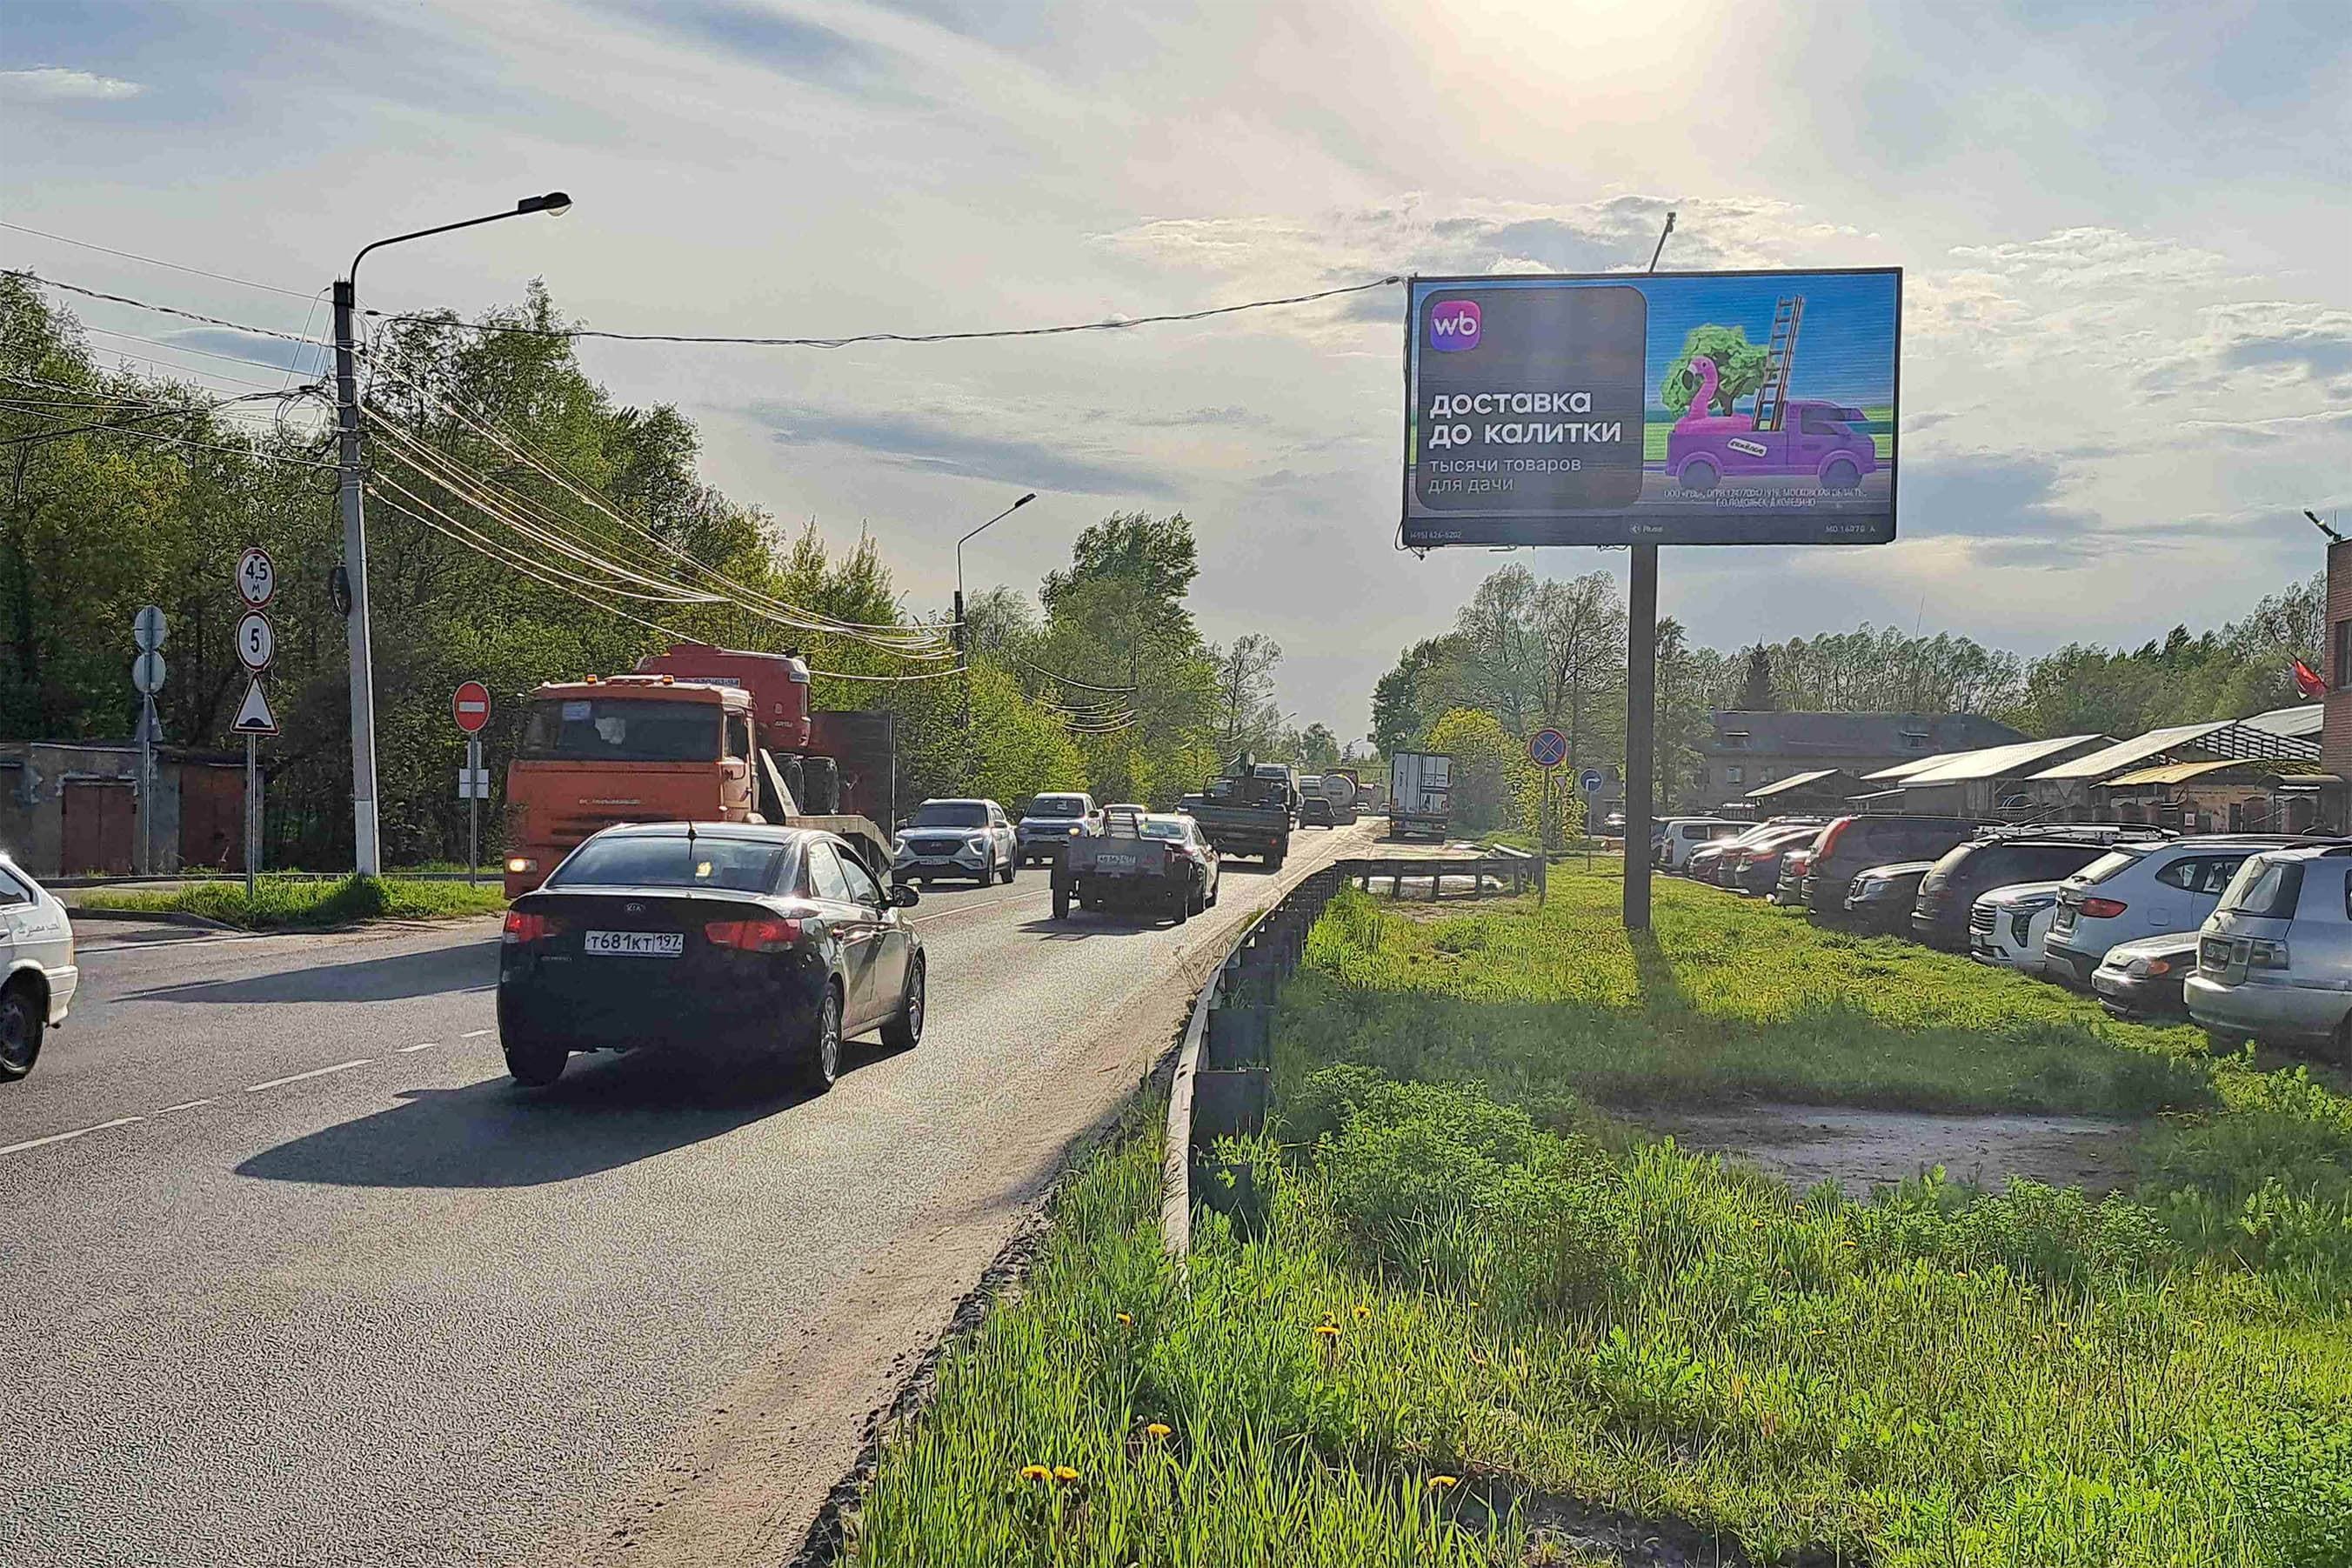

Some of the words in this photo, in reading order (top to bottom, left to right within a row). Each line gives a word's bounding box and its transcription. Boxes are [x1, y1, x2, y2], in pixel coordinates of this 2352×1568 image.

[1433, 310, 1478, 336] wb
[1429, 391, 1592, 419] доставка
[1427, 424, 1473, 450] до
[1484, 422, 1621, 444] калитки
[1429, 458, 1499, 473] тысячи
[1504, 457, 1581, 475] товаров
[1428, 480, 1462, 495] для
[1467, 478, 1514, 495] дачи
[250, 628, 260, 653] 5
